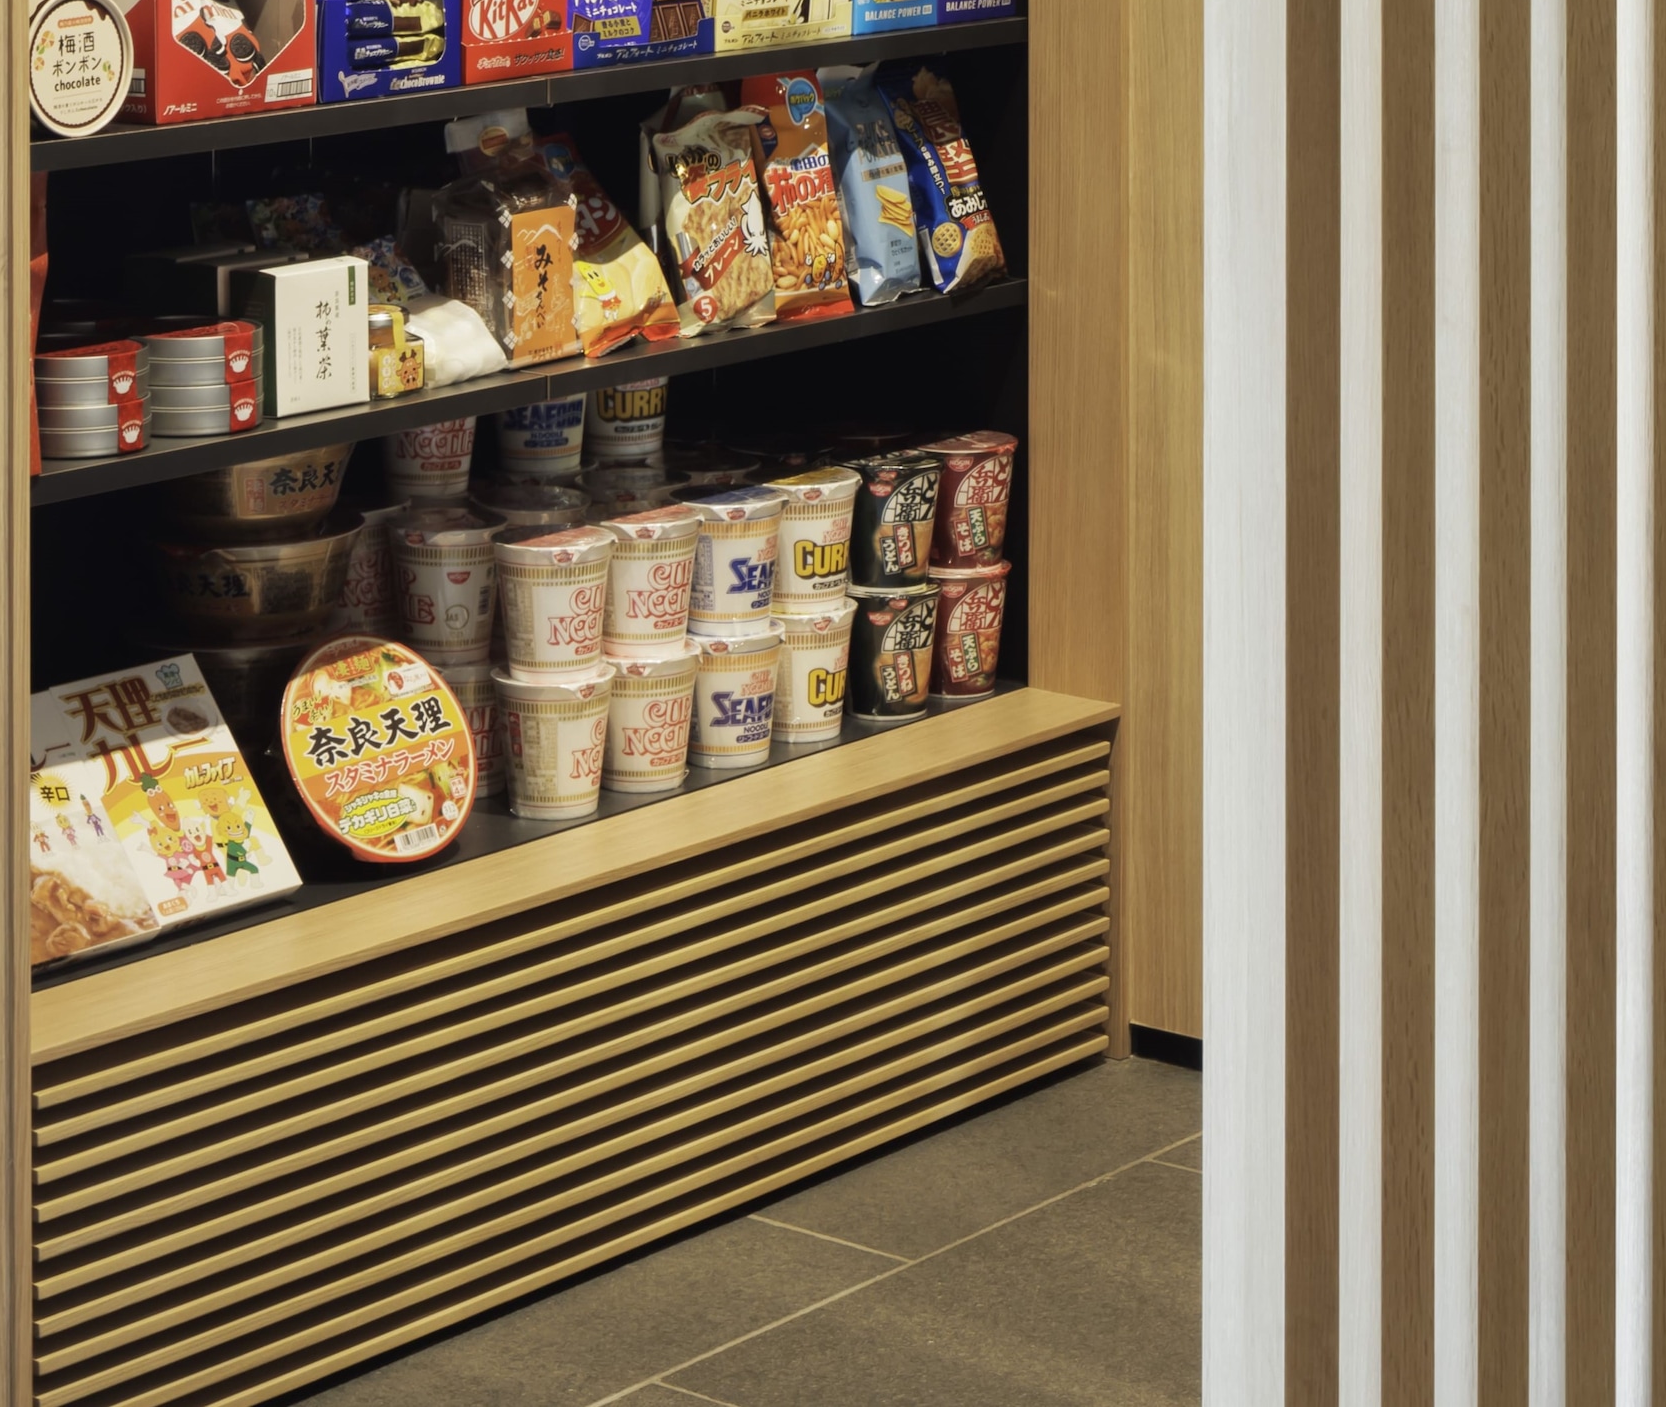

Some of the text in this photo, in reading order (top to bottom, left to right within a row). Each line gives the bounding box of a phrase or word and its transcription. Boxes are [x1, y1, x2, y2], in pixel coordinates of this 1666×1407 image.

[585, 2, 637, 18] ミニチョコレート
[865, 5, 921, 22] BALANCE POWER
[946, 0, 977, 12] BALANCE
[601, 18, 631, 29] 香る小麦と
[602, 27, 635, 38] ミルクのコク
[742, 32, 778, 45] アルフォート
[58, 31, 95, 56] 梅酒
[52, 55, 102, 78] ボンボン
[54, 76, 101, 92] chocolate
[704, 235, 740, 285] プレーン
[700, 298, 713, 317] 5
[269, 460, 341, 497] 奈良天
[957, 522, 973, 552] そば
[969, 508, 986, 546] 天ぷら
[883, 539, 900, 572] うどん
[897, 527, 913, 565] きつね
[569, 583, 606, 615] CU
[950, 649, 966, 678] そば
[962, 635, 979, 672] 天ぷら
[883, 668, 900, 700] うどん
[897, 655, 913, 692] きつね
[59, 674, 162, 743] 天理
[306, 696, 452, 767] 奈良天理
[88, 733, 211, 795] カレー
[325, 738, 455, 798] スタミナラーメン
[40, 785, 71, 803] 辛口
